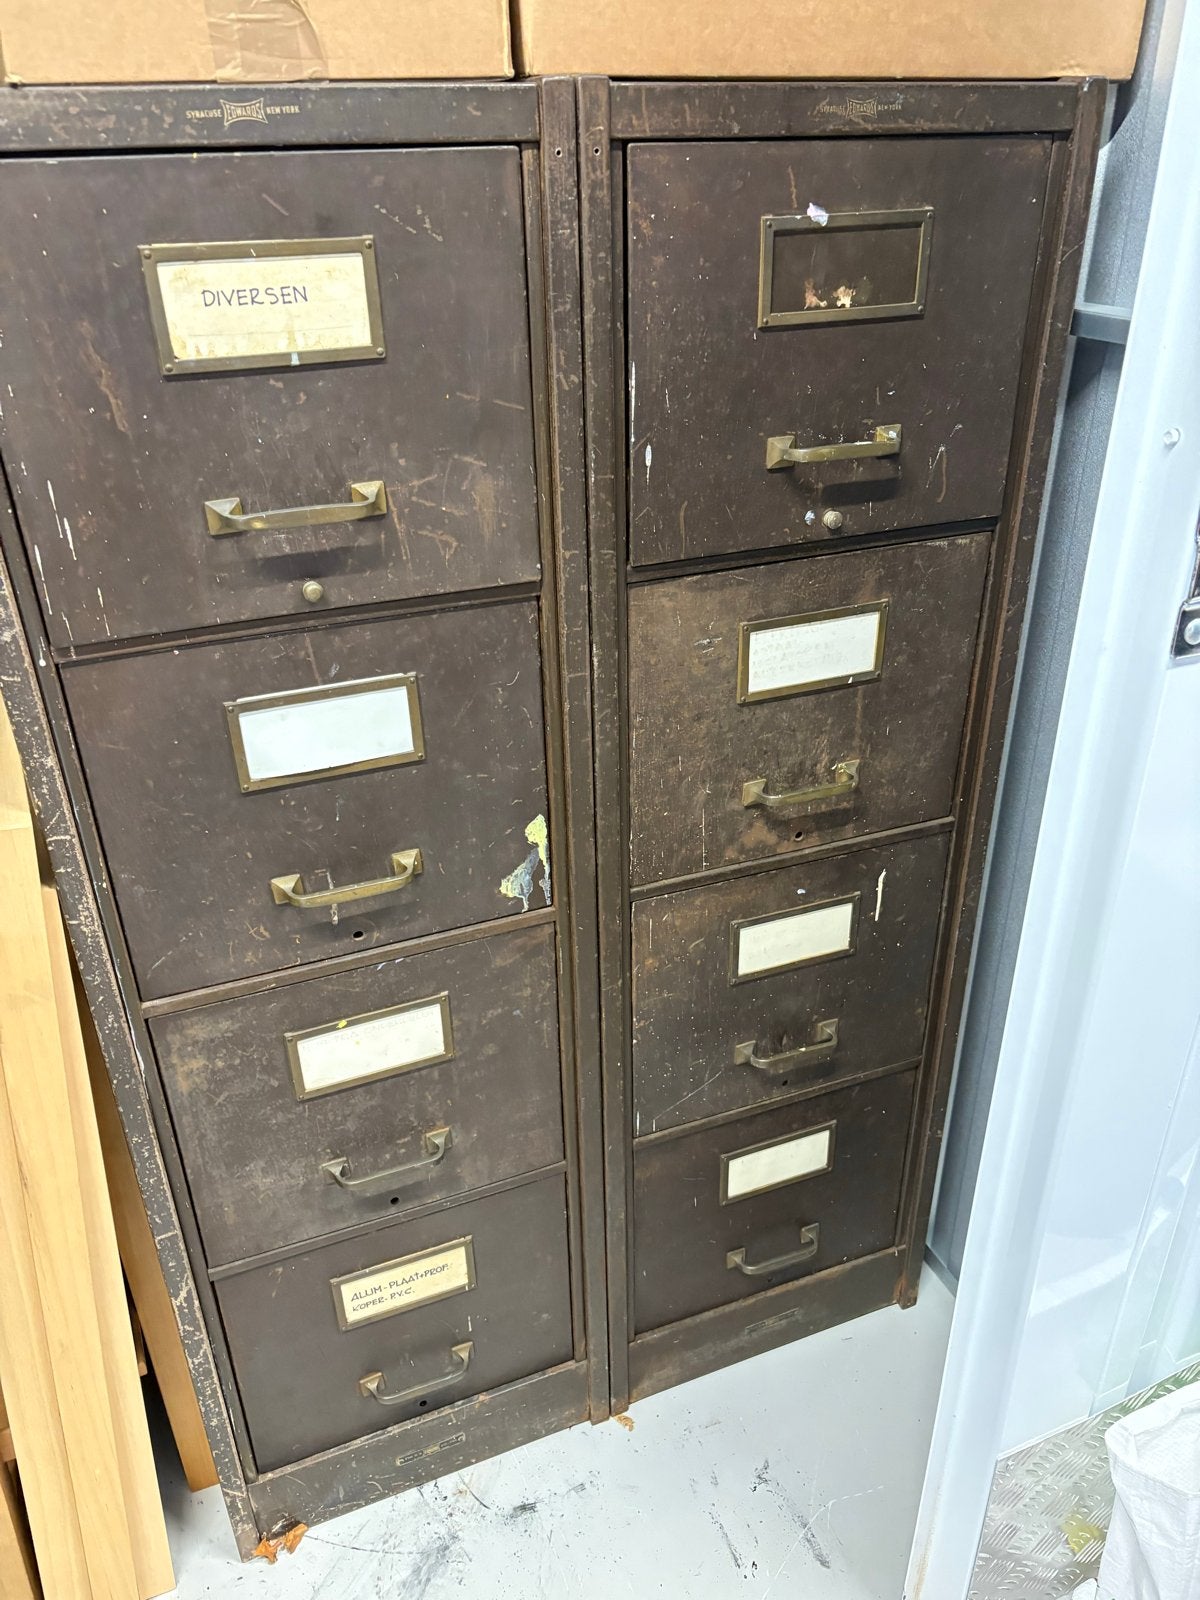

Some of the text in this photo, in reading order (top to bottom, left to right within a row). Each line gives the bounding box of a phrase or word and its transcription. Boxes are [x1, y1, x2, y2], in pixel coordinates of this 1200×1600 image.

[185, 103, 300, 120] SYRACUSE EDWARDS NEW YORK
[201, 285, 308, 307] DIVERSEN
